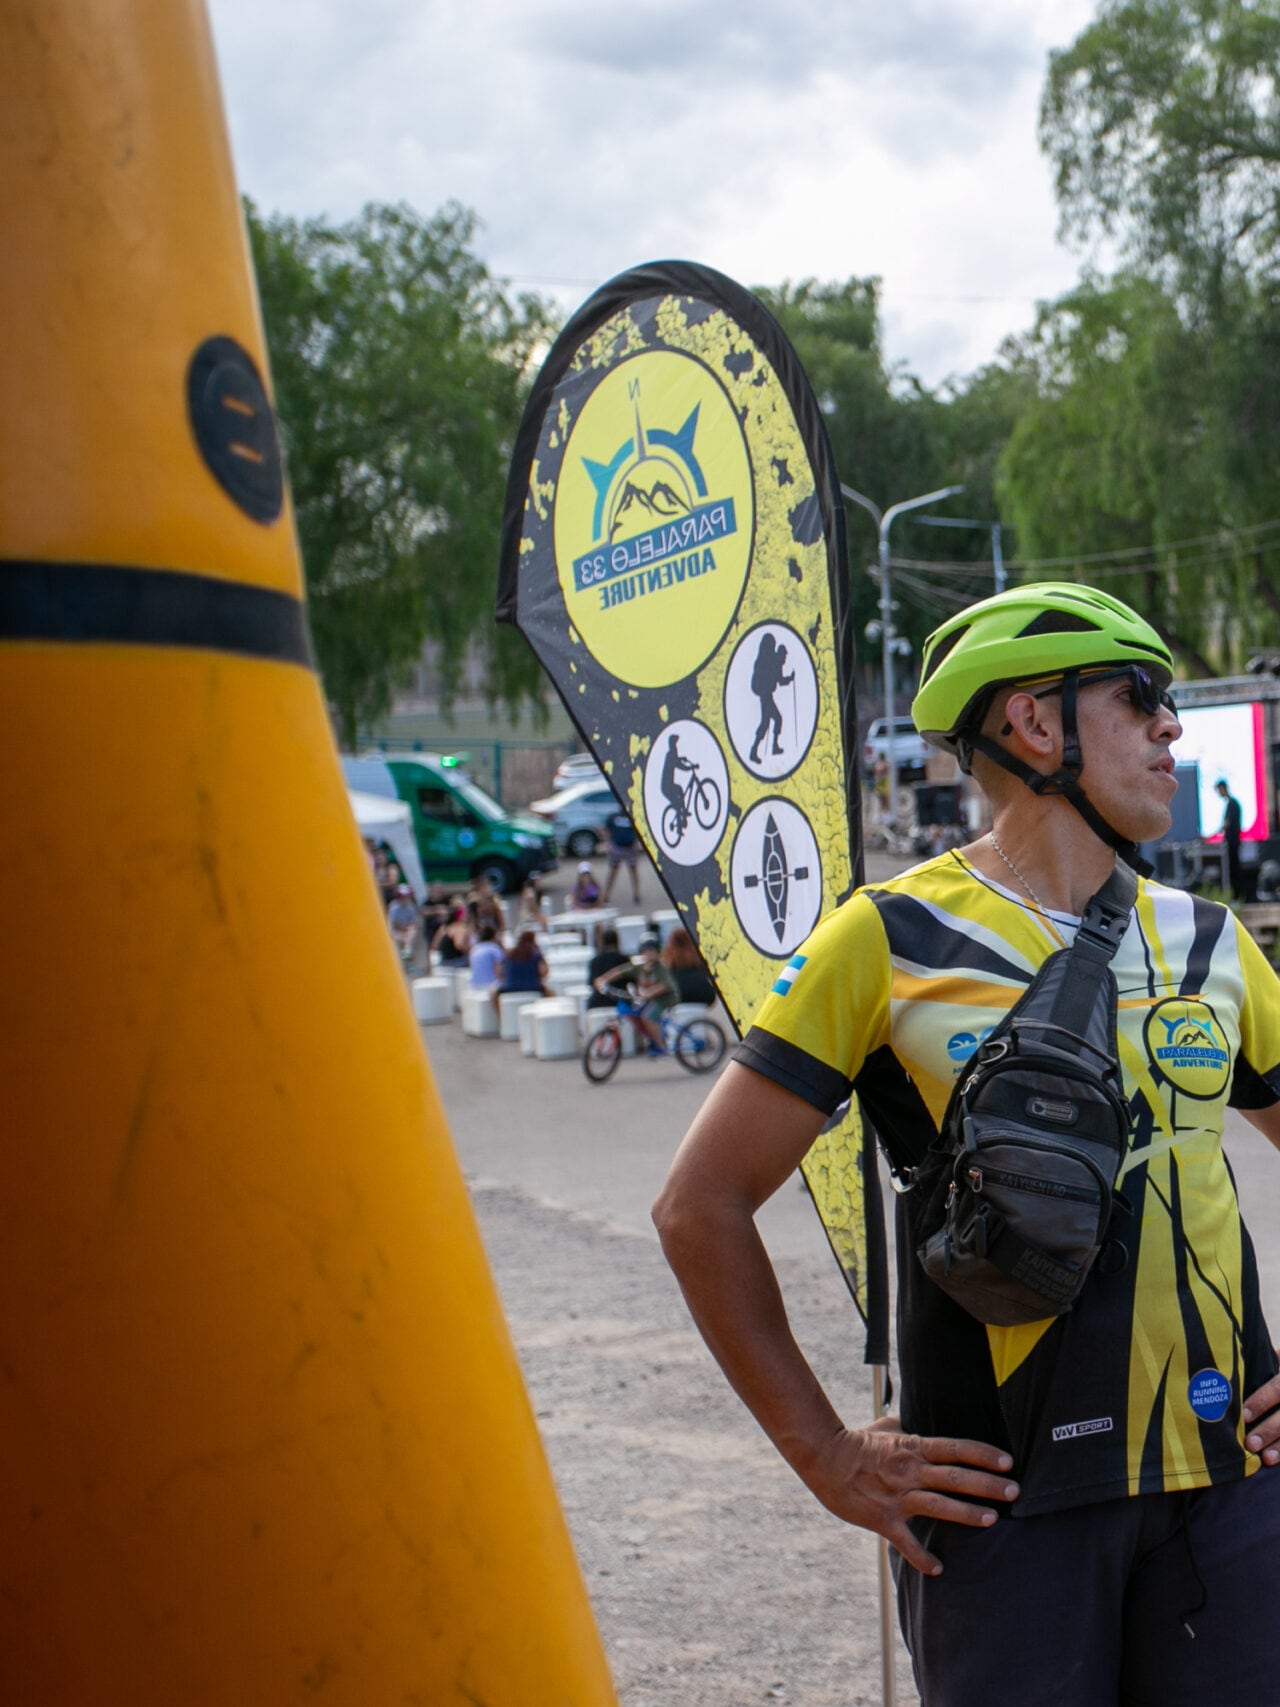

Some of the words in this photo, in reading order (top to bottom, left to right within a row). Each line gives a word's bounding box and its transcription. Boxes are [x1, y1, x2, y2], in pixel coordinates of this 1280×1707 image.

[1200, 1379, 1218, 1388] INFO
[1193, 1385, 1227, 1397] RUNNING
[1192, 1394, 1228, 1406] MENDOZA
[1079, 1421, 1109, 1432] SPORT
